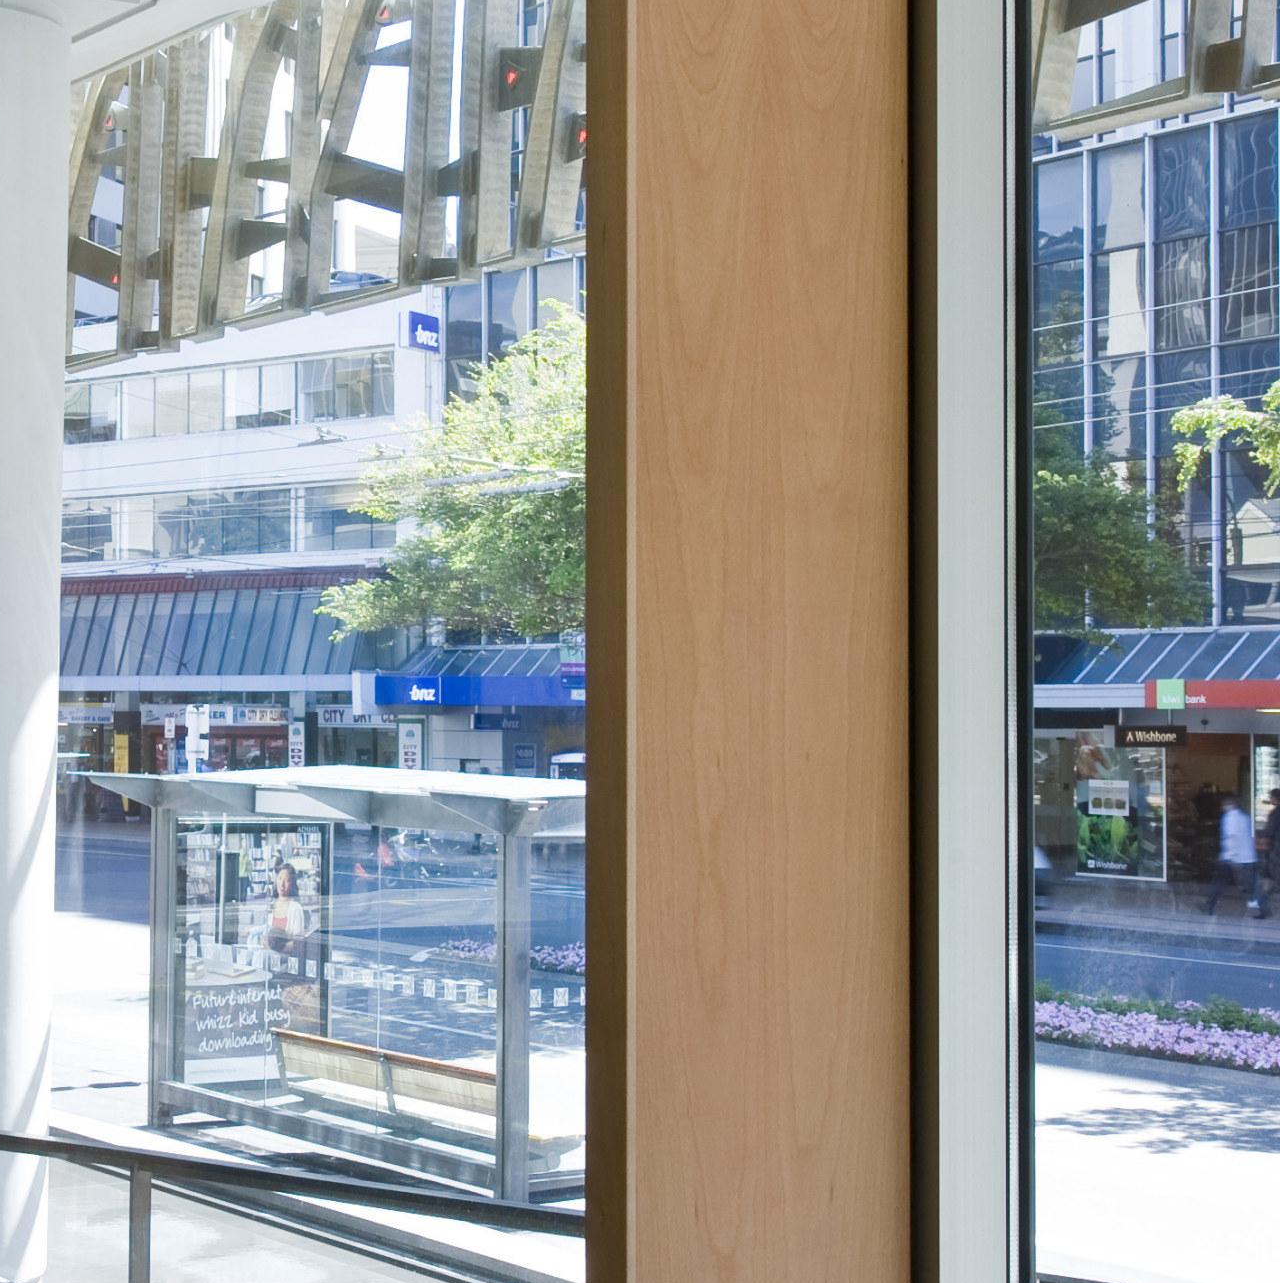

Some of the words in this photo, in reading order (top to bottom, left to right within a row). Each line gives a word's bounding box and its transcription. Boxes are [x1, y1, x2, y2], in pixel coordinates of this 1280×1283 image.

[415, 323, 438, 347] bnz
[409, 684, 436, 701] bnz
[323, 709, 345, 723] CITY
[502, 718, 520, 729] bnz
[1135, 731, 1177, 743] Wishbone
[237, 984, 282, 1004] internet
[195, 1014, 234, 1032] whizz
[264, 1008, 291, 1028] busy
